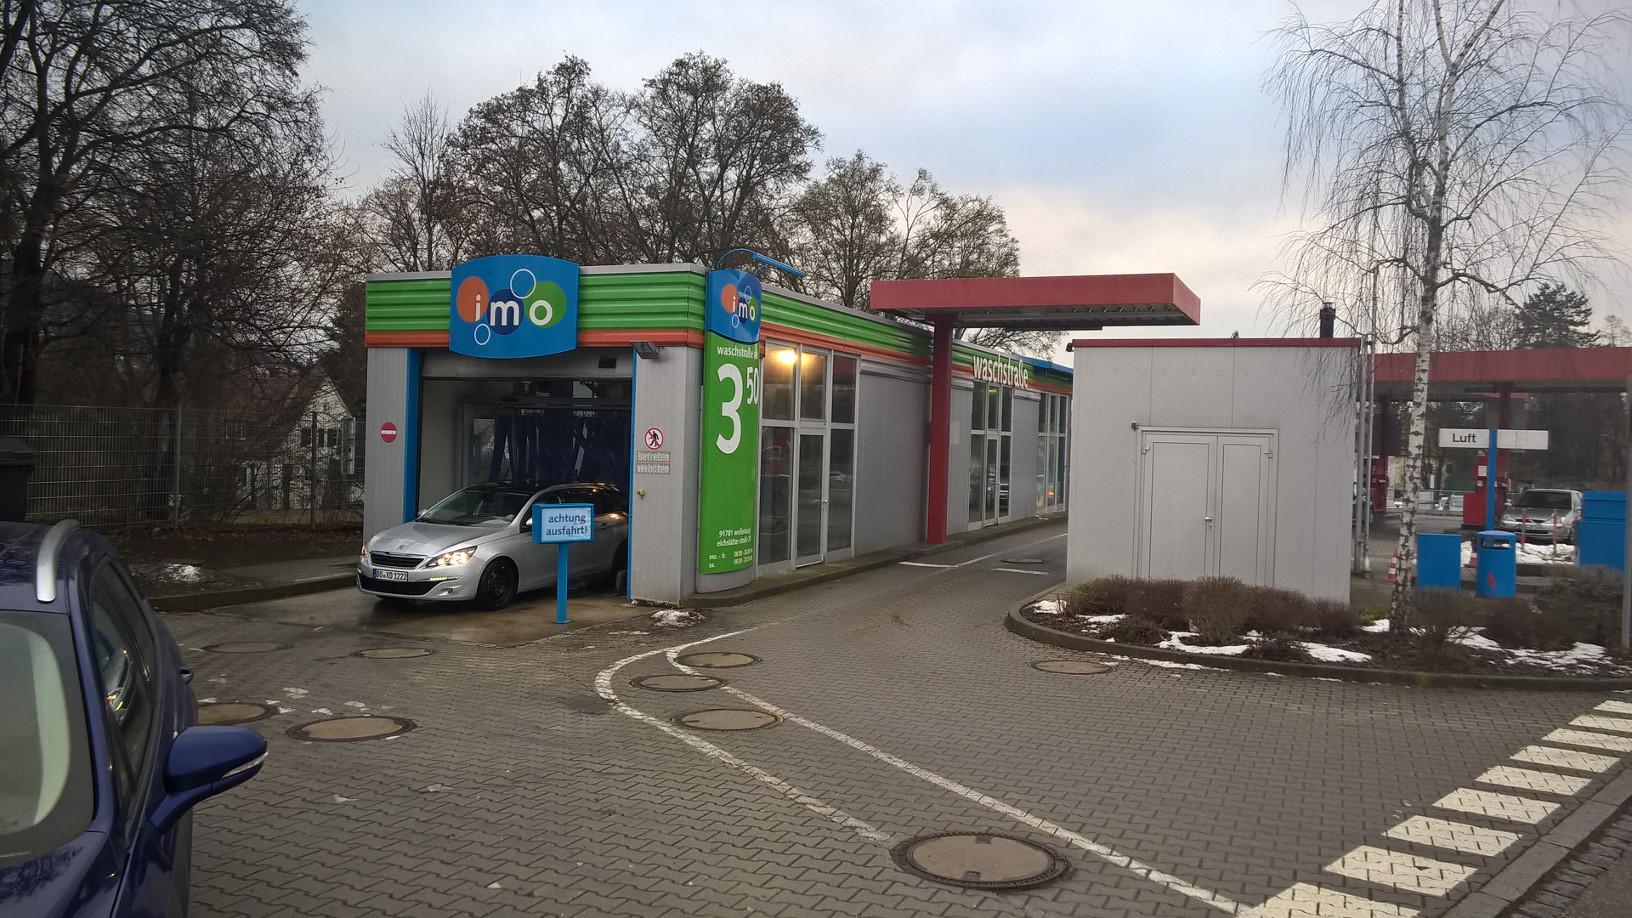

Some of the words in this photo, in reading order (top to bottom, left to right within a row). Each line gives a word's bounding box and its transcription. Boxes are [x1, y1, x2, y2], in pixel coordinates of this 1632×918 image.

[475, 294, 553, 326] imo
[732, 295, 755, 321] imo
[973, 352, 1029, 389] waschstraße
[716, 363, 743, 454] 3
[746, 366, 760, 405] 50
[1452, 433, 1477, 443] Luft
[545, 525, 588, 536] ausfahrt!
[548, 513, 586, 525] achtung
